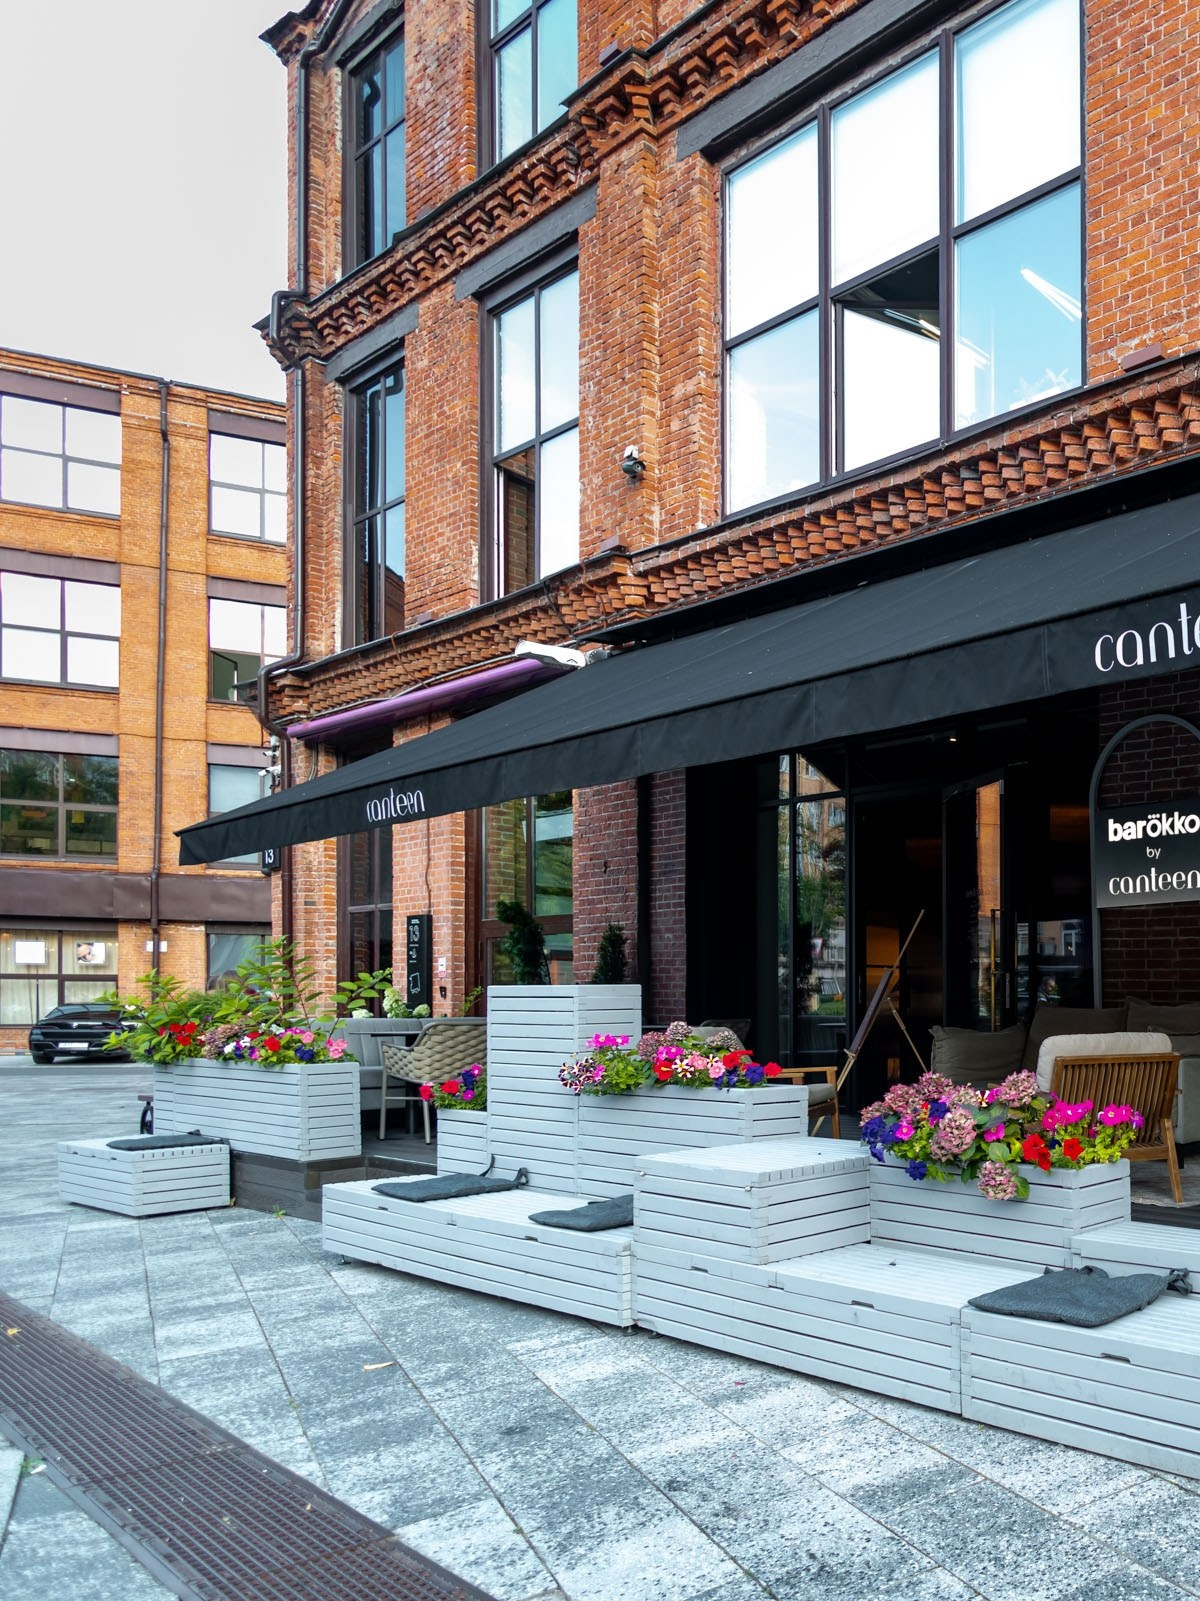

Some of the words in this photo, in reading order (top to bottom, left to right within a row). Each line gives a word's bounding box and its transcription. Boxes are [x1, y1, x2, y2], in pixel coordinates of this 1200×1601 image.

[366, 787, 425, 823] canteen
[265, 848, 274, 864] 13
[1146, 846, 1161, 859] by
[409, 925, 420, 942] 13
